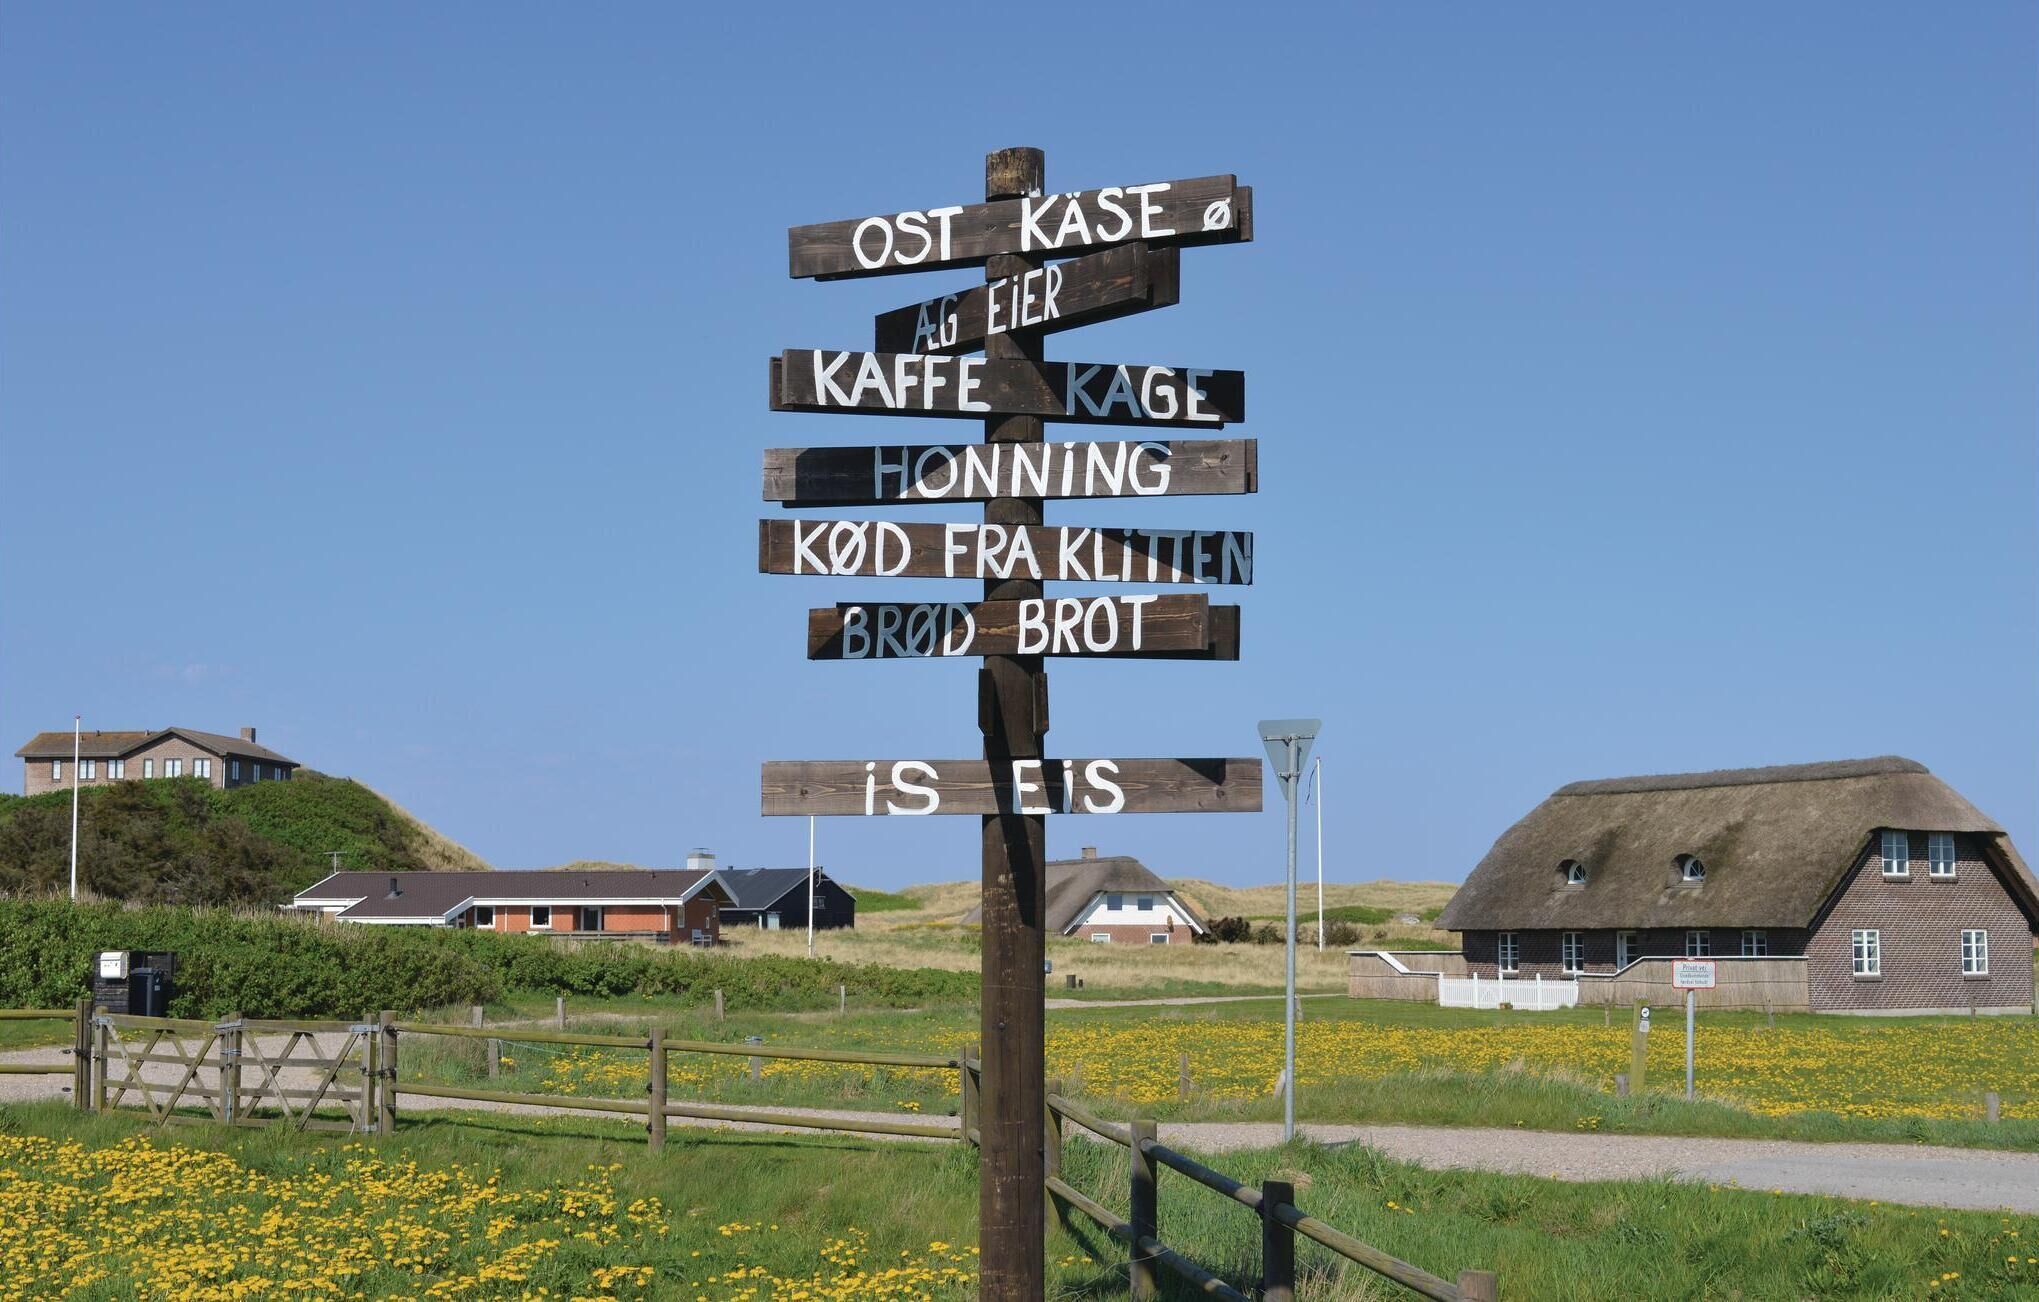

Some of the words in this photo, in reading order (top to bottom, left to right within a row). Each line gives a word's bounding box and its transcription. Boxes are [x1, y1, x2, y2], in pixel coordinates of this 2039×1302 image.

[853, 206, 963, 269] OST
[1020, 182, 1176, 252] KÄSE
[911, 294, 958, 355] ÆG
[813, 349, 991, 412] KAFFE
[1066, 361, 1221, 422] KAGE
[793, 519, 911, 576] KØD
[944, 522, 1042, 580] FRA
[842, 606, 975, 659] BRØD
[1017, 594, 1158, 654] BROT
